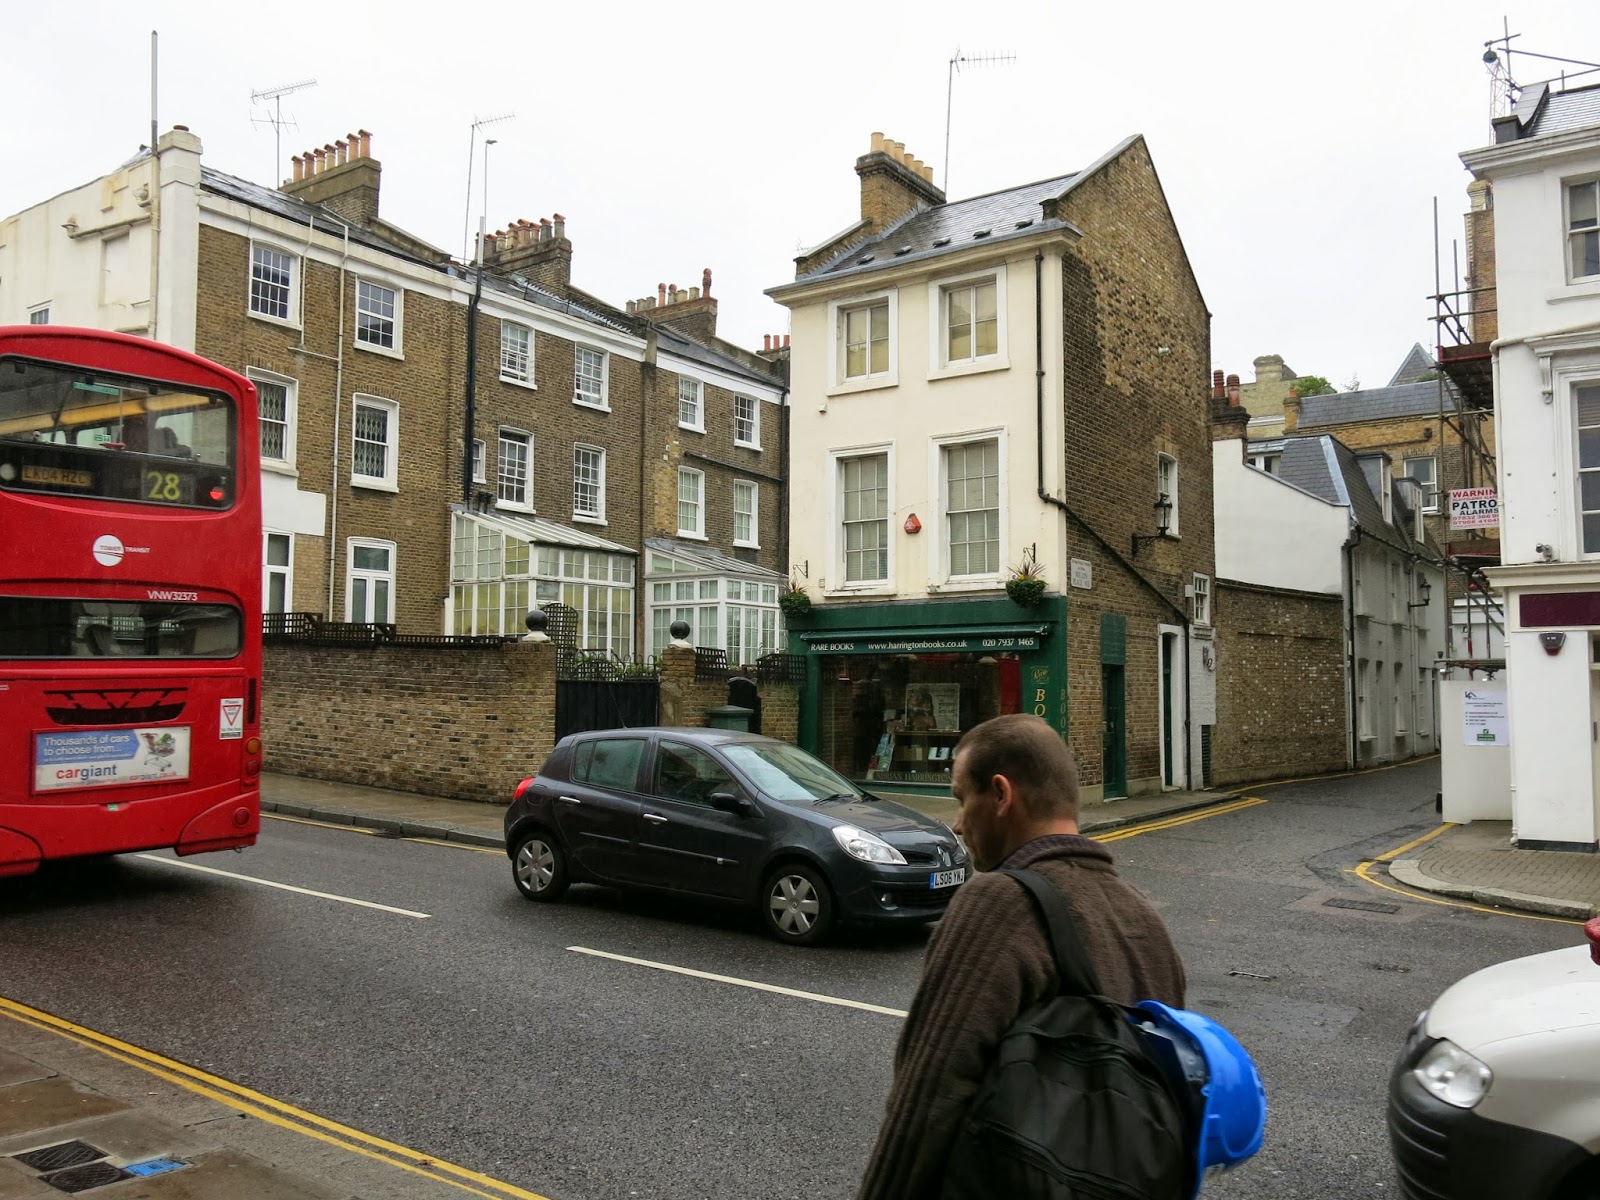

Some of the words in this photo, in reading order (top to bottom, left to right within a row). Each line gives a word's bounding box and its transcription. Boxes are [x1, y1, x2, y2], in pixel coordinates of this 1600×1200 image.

[148, 471, 181, 500] 28
[1452, 489, 1497, 498] WARNIN
[1452, 499, 1497, 510] PATRO
[147, 590, 198, 601] VNW32373
[868, 640, 967, 650] www.harringtonbooks.co.uk
[997, 638, 1015, 646] 7937
[1018, 638, 1034, 646] 1465
[1034, 688, 1046, 717] BO
[44, 736, 97, 747] Thousands
[99, 735, 109, 744] of
[110, 735, 130, 743] cars
[44, 748, 54, 756] to
[55, 746, 91, 755] choose
[56, 764, 117, 781] cargiant
